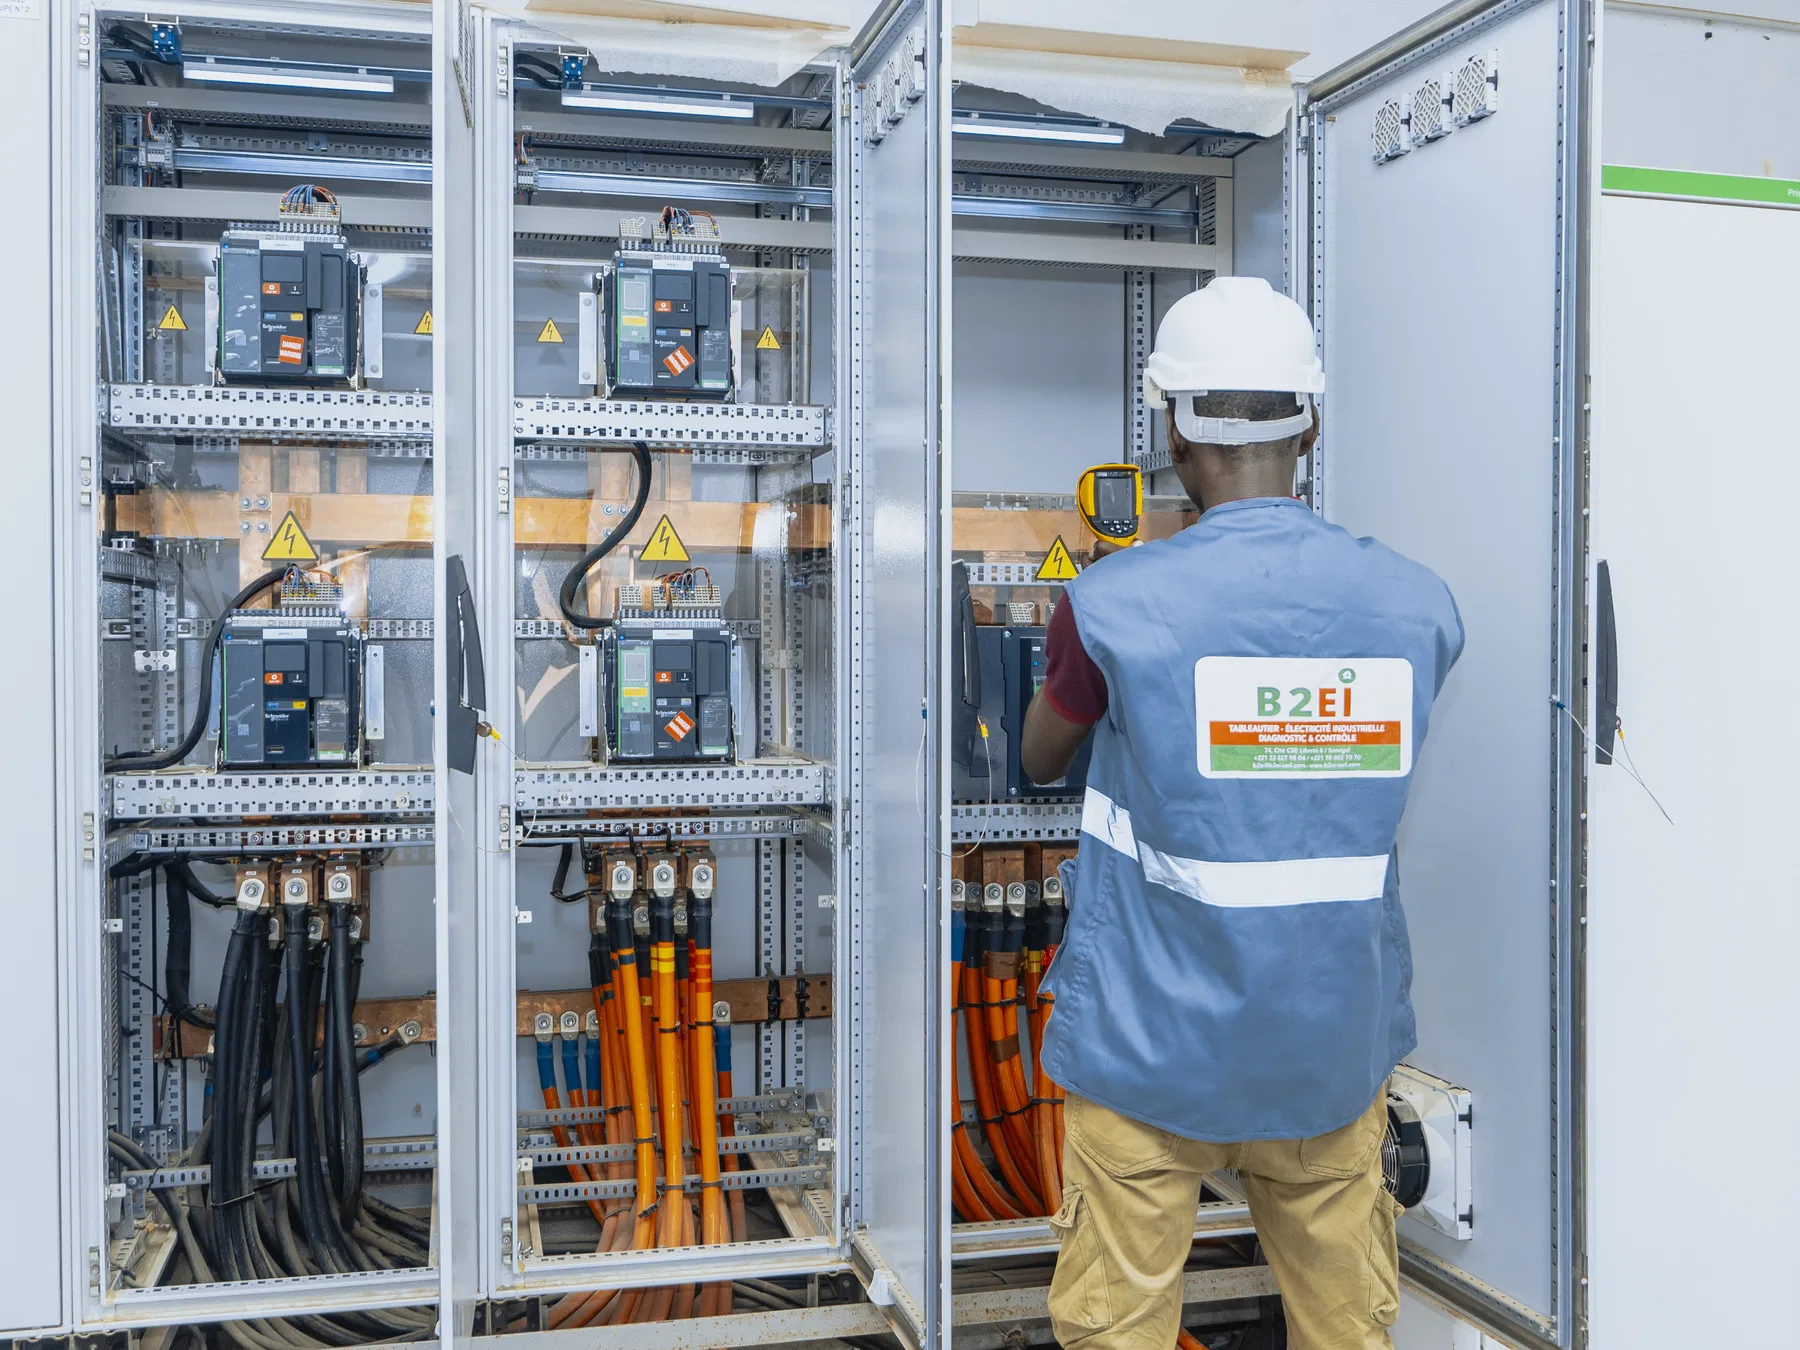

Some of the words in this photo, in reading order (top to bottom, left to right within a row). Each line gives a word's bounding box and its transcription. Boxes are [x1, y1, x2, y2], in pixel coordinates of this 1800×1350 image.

[262, 323, 287, 332] Schneider
[281, 340, 302, 350] DANGER
[654, 339, 678, 348] Schneider
[264, 713, 289, 722] Schneider
[1228, 724, 1279, 733] TABLEAUTIER
[1285, 722, 1331, 732] ÉLECTRICITÉ
[1332, 724, 1385, 732] INDUSTRIELLE
[1258, 734, 1306, 743] DIAGNOSTIC
[1308, 734, 1314, 743] &
[1315, 732, 1357, 742] CONTRÔLE
